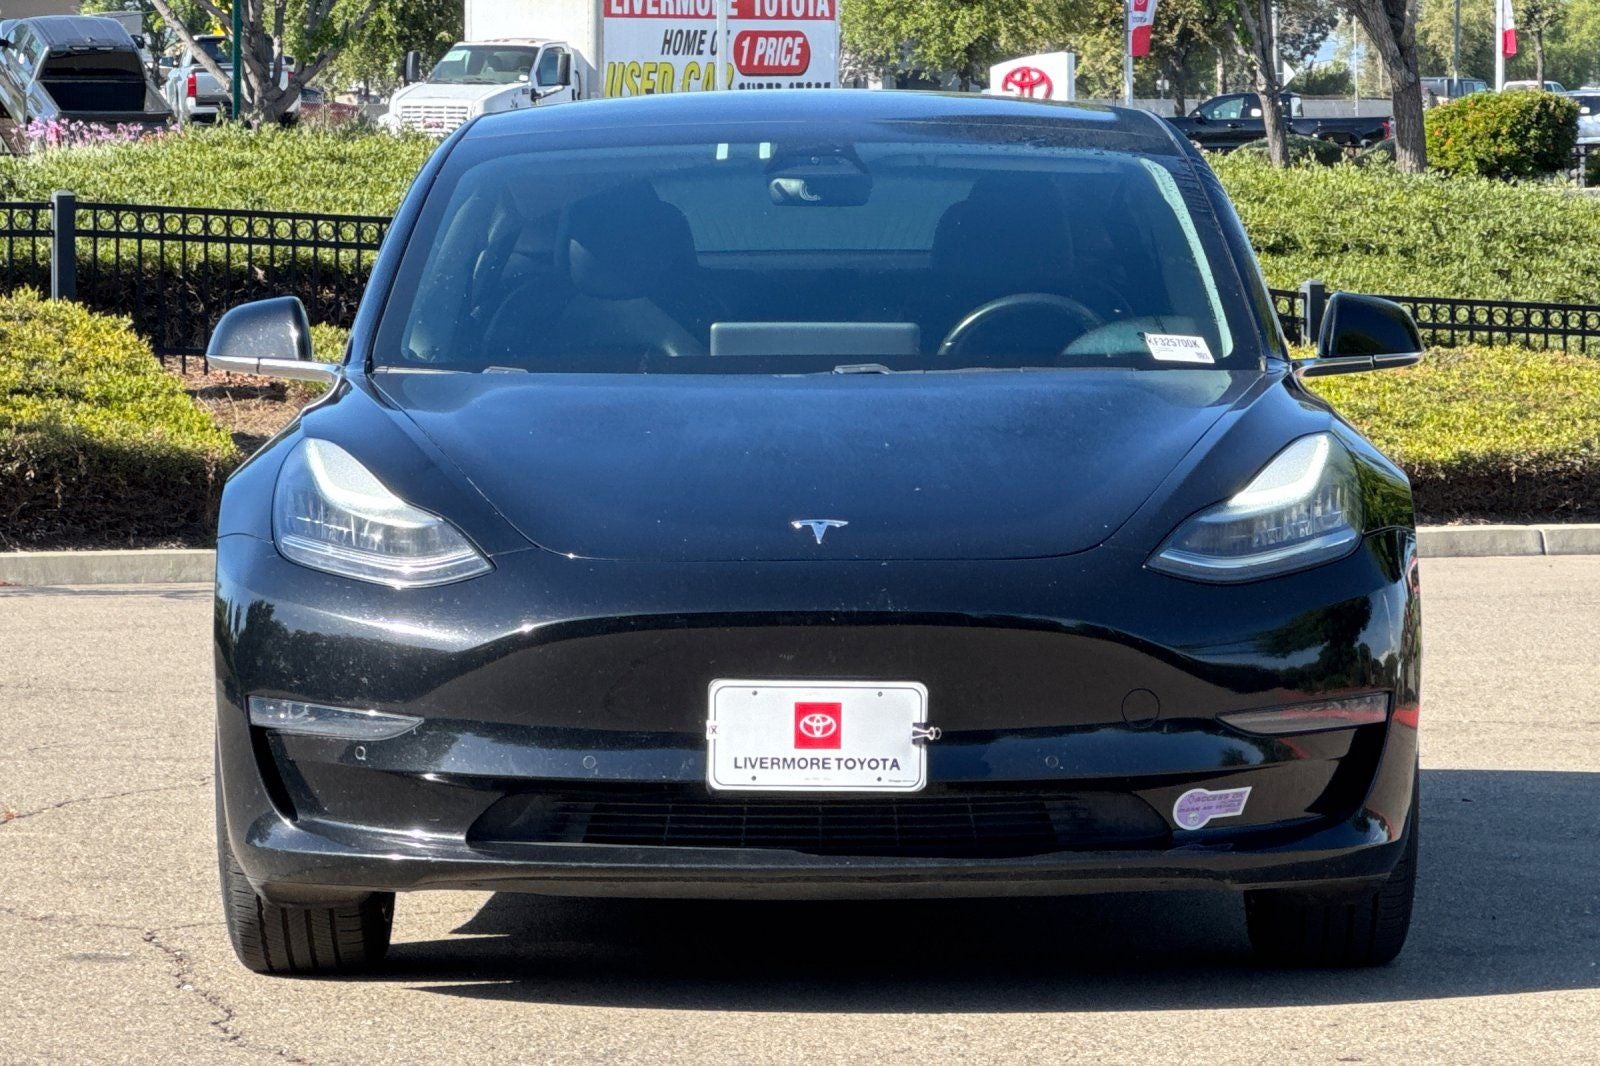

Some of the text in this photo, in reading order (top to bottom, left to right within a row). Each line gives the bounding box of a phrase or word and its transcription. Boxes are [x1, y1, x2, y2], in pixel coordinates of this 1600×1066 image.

[660, 29, 731, 56] HOME O
[741, 36, 804, 67] 1 PRICE
[682, 61, 734, 92] CA
[733, 756, 901, 771] LIVERMORE TOYOTA
